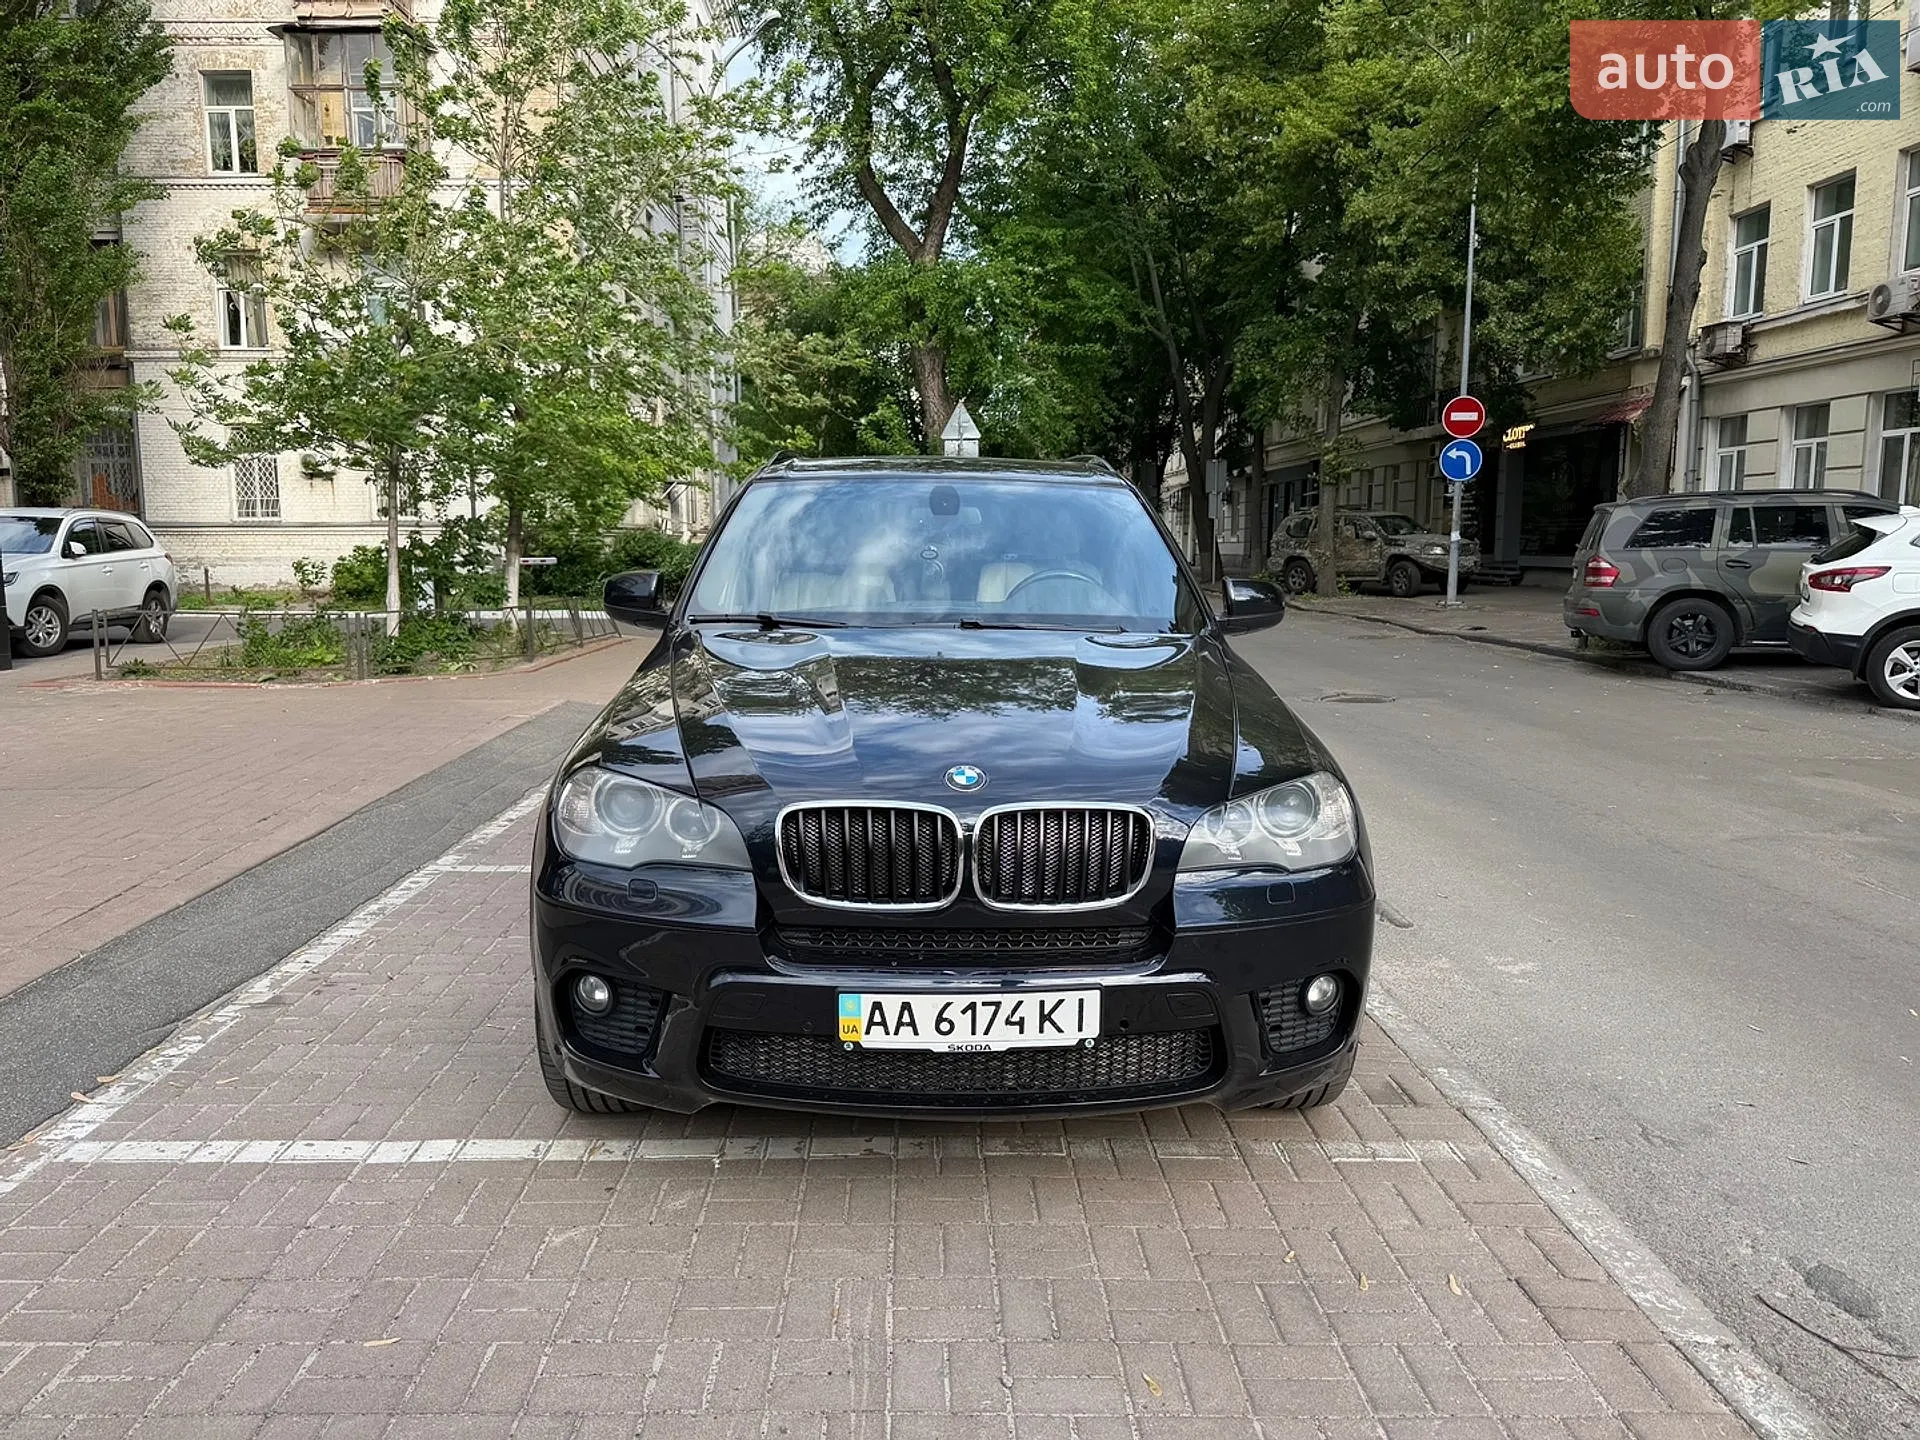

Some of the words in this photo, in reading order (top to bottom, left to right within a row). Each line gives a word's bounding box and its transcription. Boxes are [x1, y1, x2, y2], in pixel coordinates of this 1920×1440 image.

[864, 1001, 919, 1036] AA
[934, 1001, 1024, 1036] 6174
[1038, 998, 1084, 1034] KI
[842, 1025, 858, 1034] UA
